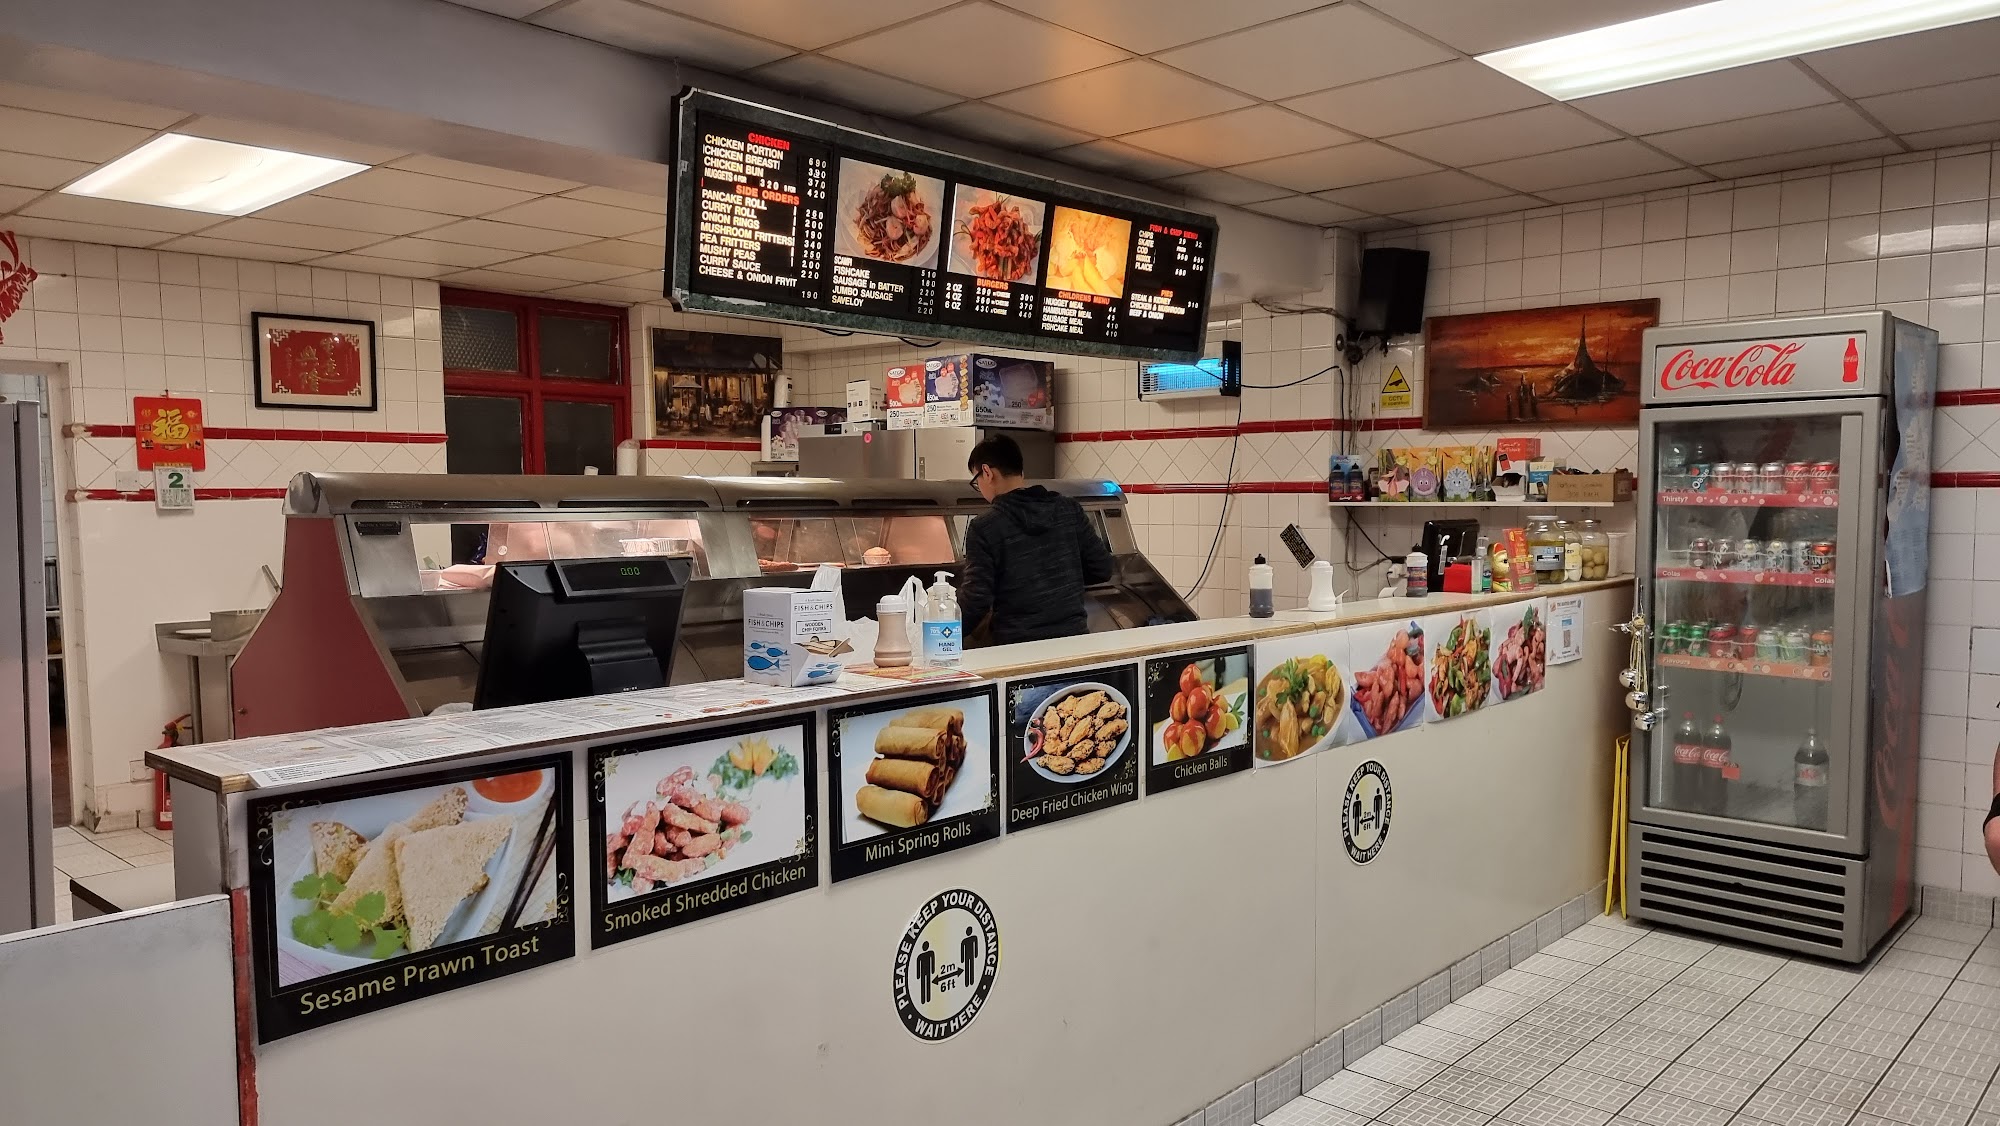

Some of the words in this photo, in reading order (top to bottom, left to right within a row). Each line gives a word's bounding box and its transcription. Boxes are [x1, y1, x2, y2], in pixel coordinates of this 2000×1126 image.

[704, 134, 744, 151] CHICKEN
[747, 143, 783, 160] PORTION
[748, 132, 790, 151] CHICKEN
[704, 145, 743, 162] CHICKEN
[745, 154, 778, 169] BREAST
[704, 156, 743, 173] CHICKEN
[745, 166, 764, 178] BUN
[704, 167, 733, 182] NUGGETS
[701, 189, 743, 205] PANCAKE
[745, 198, 768, 210] ROLL
[736, 185, 759, 197] SIDE
[762, 189, 800, 206] ORDERS
[701, 200, 732, 214] CURRY
[735, 206, 757, 219] ROLL
[701, 211, 731, 225] ONION
[733, 217, 760, 230] RINGS
[700, 222, 752, 239] MUSHROOM
[755, 231, 793, 247] FRITTERS
[1138, 229, 1154, 239] CHIPS
[700, 232, 718, 244] PEA
[720, 236, 761, 252] FRITTERS
[1138, 238, 1155, 248] SKATE
[699, 243, 731, 257] MUSHY
[733, 249, 756, 261] PEAS
[1137, 246, 1149, 255] COD
[699, 254, 730, 268] CURRY
[732, 259, 761, 272] SAUCE
[833, 255, 853, 267] SCAMPI
[1135, 261, 1153, 272] PLAICE
[698, 265, 734, 279] CHEESE
[737, 270, 743, 280] &
[746, 272, 773, 284] ONION
[834, 266, 871, 279] FISHCAKE
[833, 275, 868, 288] SAUSAGE
[878, 281, 904, 293] BATTER
[946, 282, 952, 291] 2
[952, 283, 963, 293] OZ
[976, 278, 1009, 291] BURGERS
[832, 285, 858, 297] JUMBO
[860, 289, 894, 301] SAUSAGE
[945, 291, 951, 300] 4
[952, 292, 962, 302] OZ
[1058, 291, 1092, 302] CHILDRENS
[1093, 296, 1110, 305] MENU
[1131, 293, 1148, 302] STEAK
[1153, 296, 1172, 305] KIDNEY
[1160, 289, 1174, 298] PIES
[831, 295, 864, 307] SAVELOY
[944, 300, 950, 309] 6
[951, 301, 961, 310] OZ
[1045, 297, 1069, 307] NUGGET
[1069, 301, 1084, 310] MEAL
[1130, 301, 1153, 311] CHICKEN
[1157, 304, 1186, 315] MUSHROOM
[1042, 306, 1077, 317] HAMBURGER
[1077, 310, 1093, 319] MEAL
[1042, 314, 1068, 324] SAUSAGE
[1069, 317, 1084, 326] MEAL
[1129, 308, 1143, 317] BEEF
[1148, 311, 1165, 320] ONION
[1041, 322, 1069, 333] FISHCAKE
[1069, 325, 1084, 335] MEAL
[1660, 342, 1807, 391] Coca-Cola
[152, 408, 191, 440] 福
[168, 472, 184, 489] 2
[1691, 467, 1710, 489] Oasis
[1662, 495, 1689, 503] Thirsty?
[1814, 577, 1835, 585] Colas
[814, 603, 833, 611] CHIPS
[748, 618, 761, 627] FISH
[765, 620, 784, 629] CHIPS
[1663, 657, 1691, 666] Flavours
[1174, 762, 1208, 779] Chicken
[1209, 755, 1228, 771] Balls
[1011, 803, 1040, 823] Deep
[1042, 794, 1068, 814] Fried
[1070, 788, 1108, 808] Chicken
[1110, 781, 1134, 799] Wing
[1343, 791, 1353, 839] PLEASE
[1349, 766, 1365, 791] KEEP
[1365, 762, 1382, 776] YOUR
[1380, 771, 1392, 825] DISTANCE
[865, 840, 894, 862] Mini
[898, 831, 940, 855] Spring
[943, 821, 972, 842] Rolls
[1350, 845, 1367, 862] WAIT
[1367, 836, 1384, 859] HERE
[604, 897, 671, 932] Smoked
[675, 877, 748, 913] Shredded
[752, 865, 806, 892] Chicken
[895, 942, 913, 1011] PLEASE
[907, 899, 939, 940] KEEP
[941, 892, 975, 910] YOUR
[974, 900, 999, 978] DISTANCE
[299, 974, 396, 1015] Sesame
[403, 953, 475, 987] Prawn
[480, 935, 540, 966] Toast
[940, 962, 956, 975] 2m
[940, 978, 956, 993] 6ft
[914, 1018, 948, 1038] WAIT
[949, 994, 983, 1033] HERE
